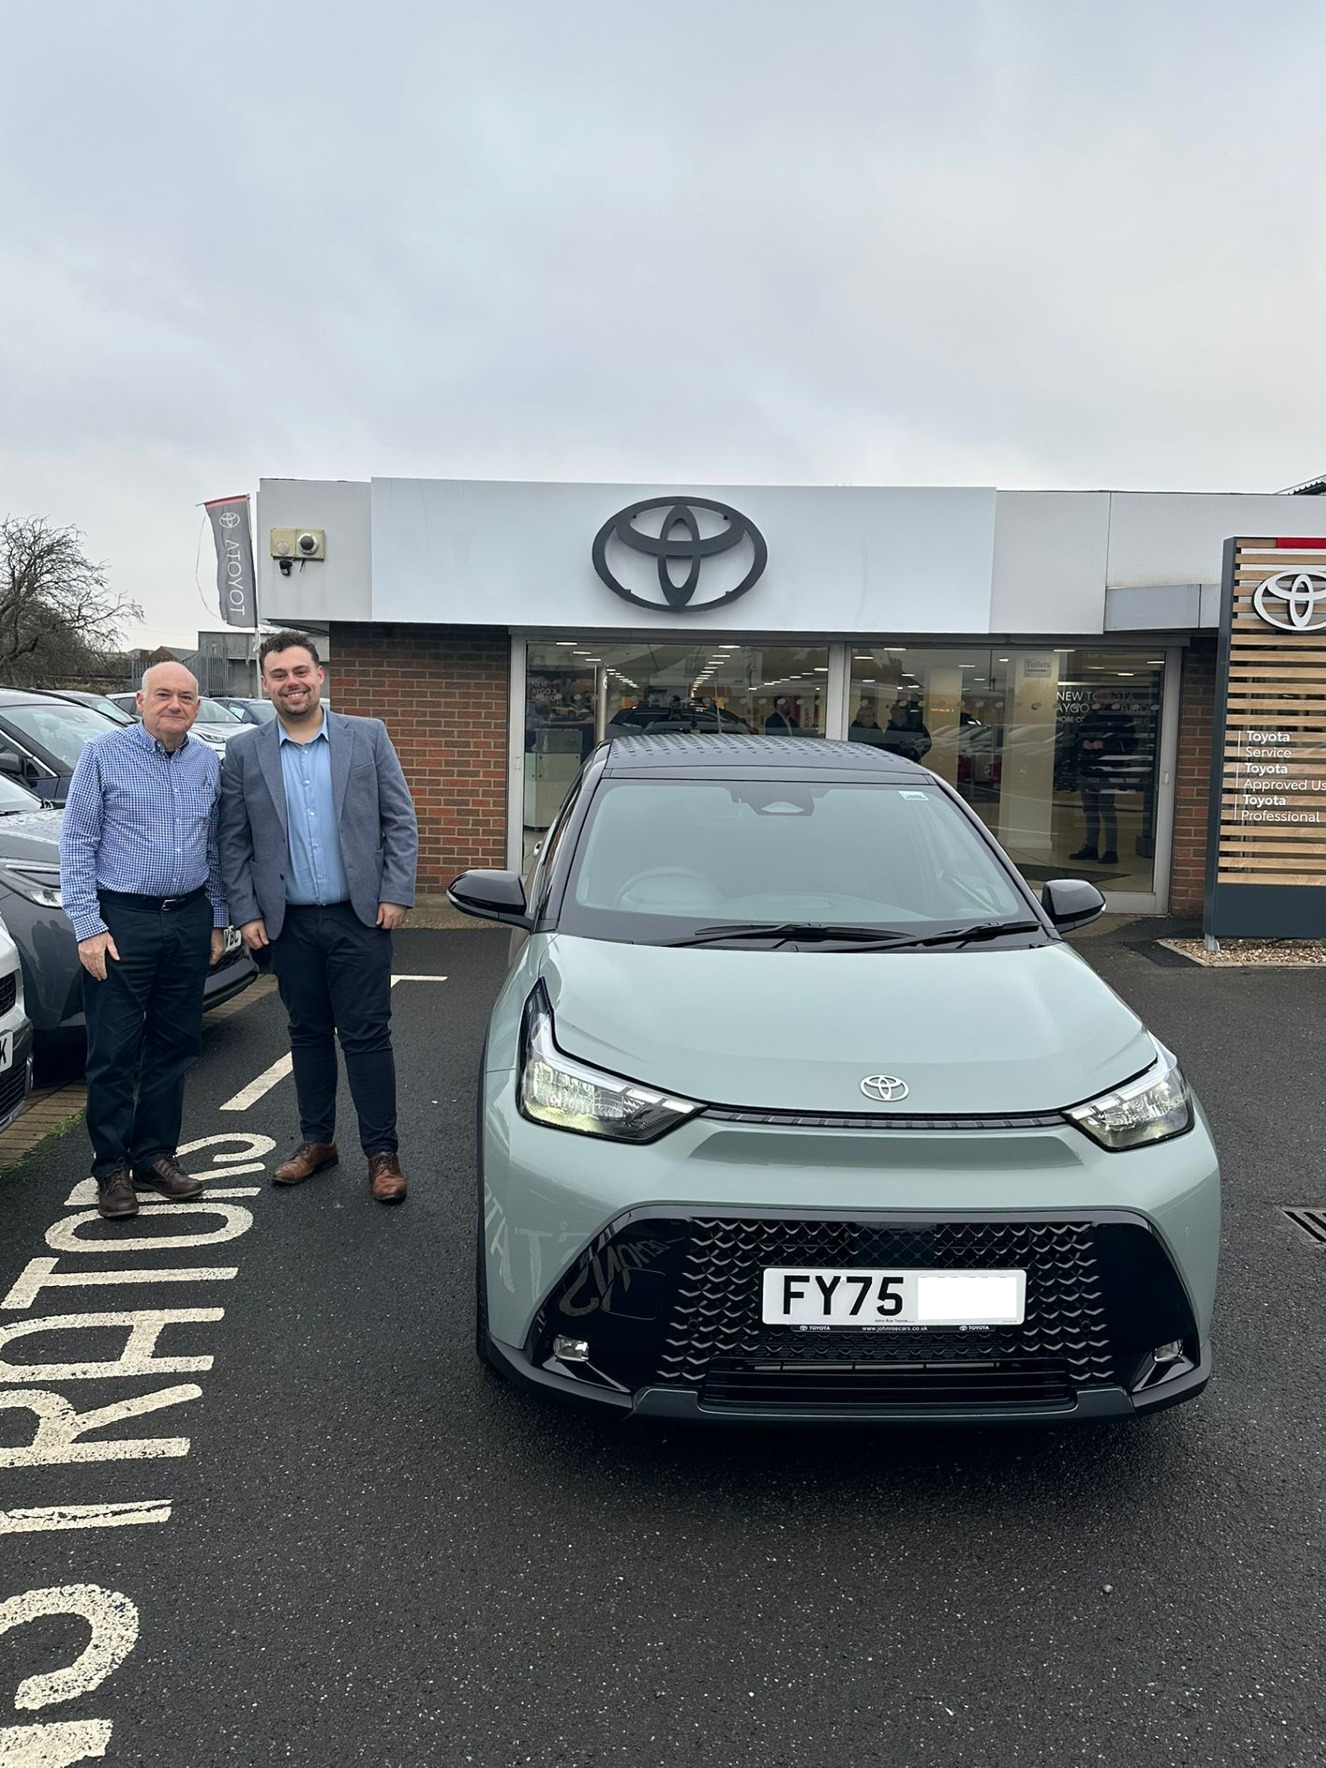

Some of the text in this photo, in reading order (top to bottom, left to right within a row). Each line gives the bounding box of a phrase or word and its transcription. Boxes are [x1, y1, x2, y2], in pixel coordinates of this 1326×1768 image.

[1056, 691, 1135, 701] NEW TOOTA
[1055, 703, 1091, 714] AYGO
[1246, 730, 1290, 745] Toyota
[1245, 746, 1292, 759] Service
[1244, 762, 1288, 777] Toyota
[1243, 778, 1307, 793] Approved
[1242, 794, 1286, 808] Toyota
[1241, 810, 1320, 823] Professional
[783, 1275, 904, 1316] FY75
